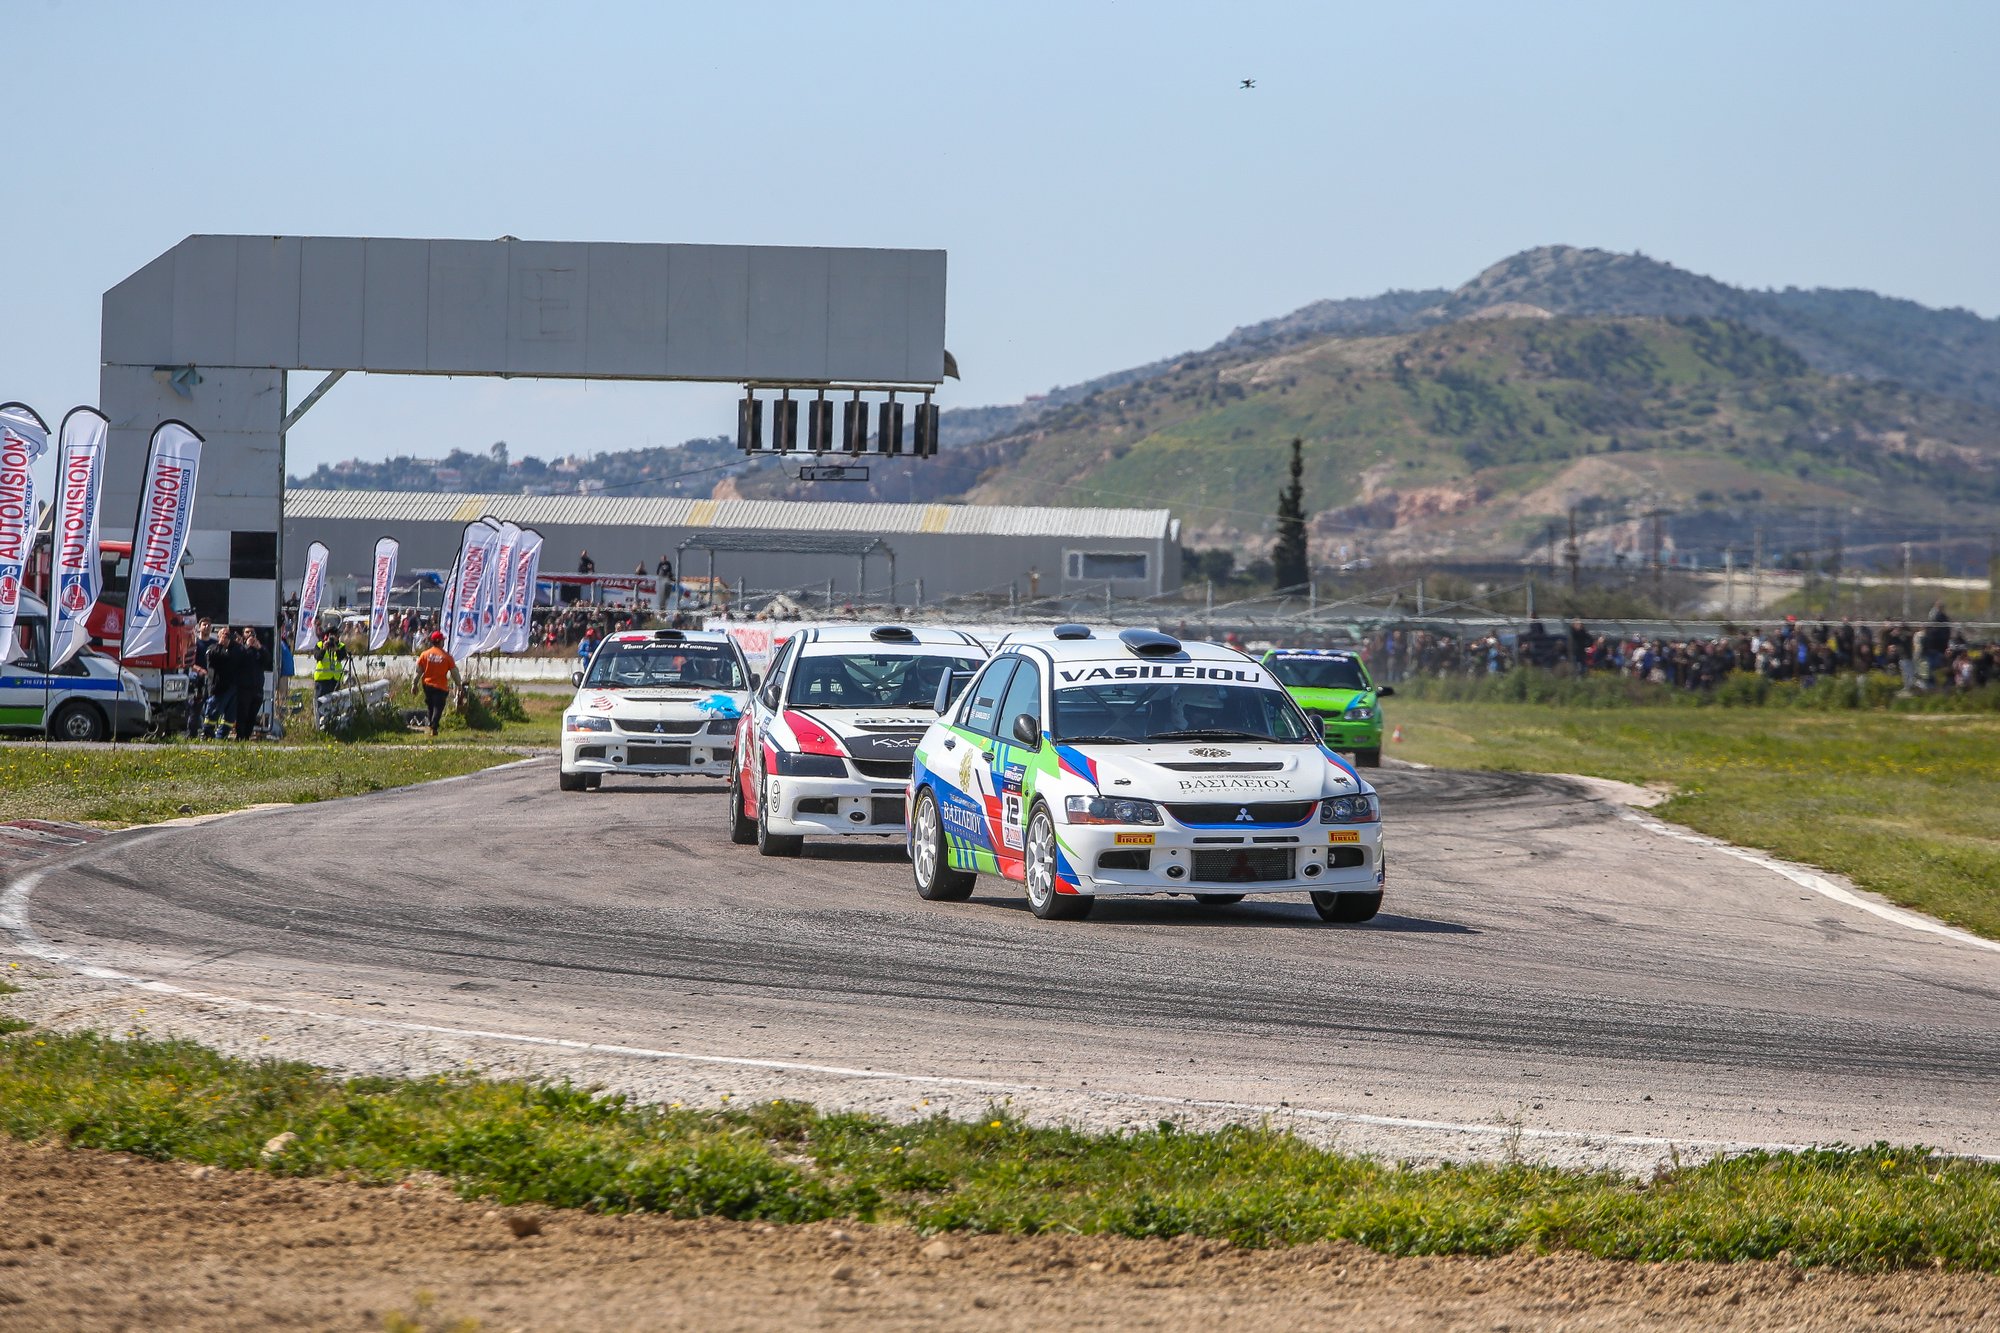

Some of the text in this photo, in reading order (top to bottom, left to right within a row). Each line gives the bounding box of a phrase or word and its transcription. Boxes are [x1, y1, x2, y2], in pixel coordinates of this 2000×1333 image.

[0, 437, 27, 561] AUTOVISION
[61, 455, 91, 569] AUTOVISION
[143, 464, 182, 573] AUTOVISION
[460, 545, 484, 611] AUTOVISION
[1059, 666, 1260, 683] VASILEIOU
[1177, 779, 1292, 790] ΒΑΣΙΛΕΙΟΥ
[1006, 795, 1020, 826] 12
[1117, 834, 1153, 844] PIRELLI
[1329, 832, 1358, 842] PIRELLI
